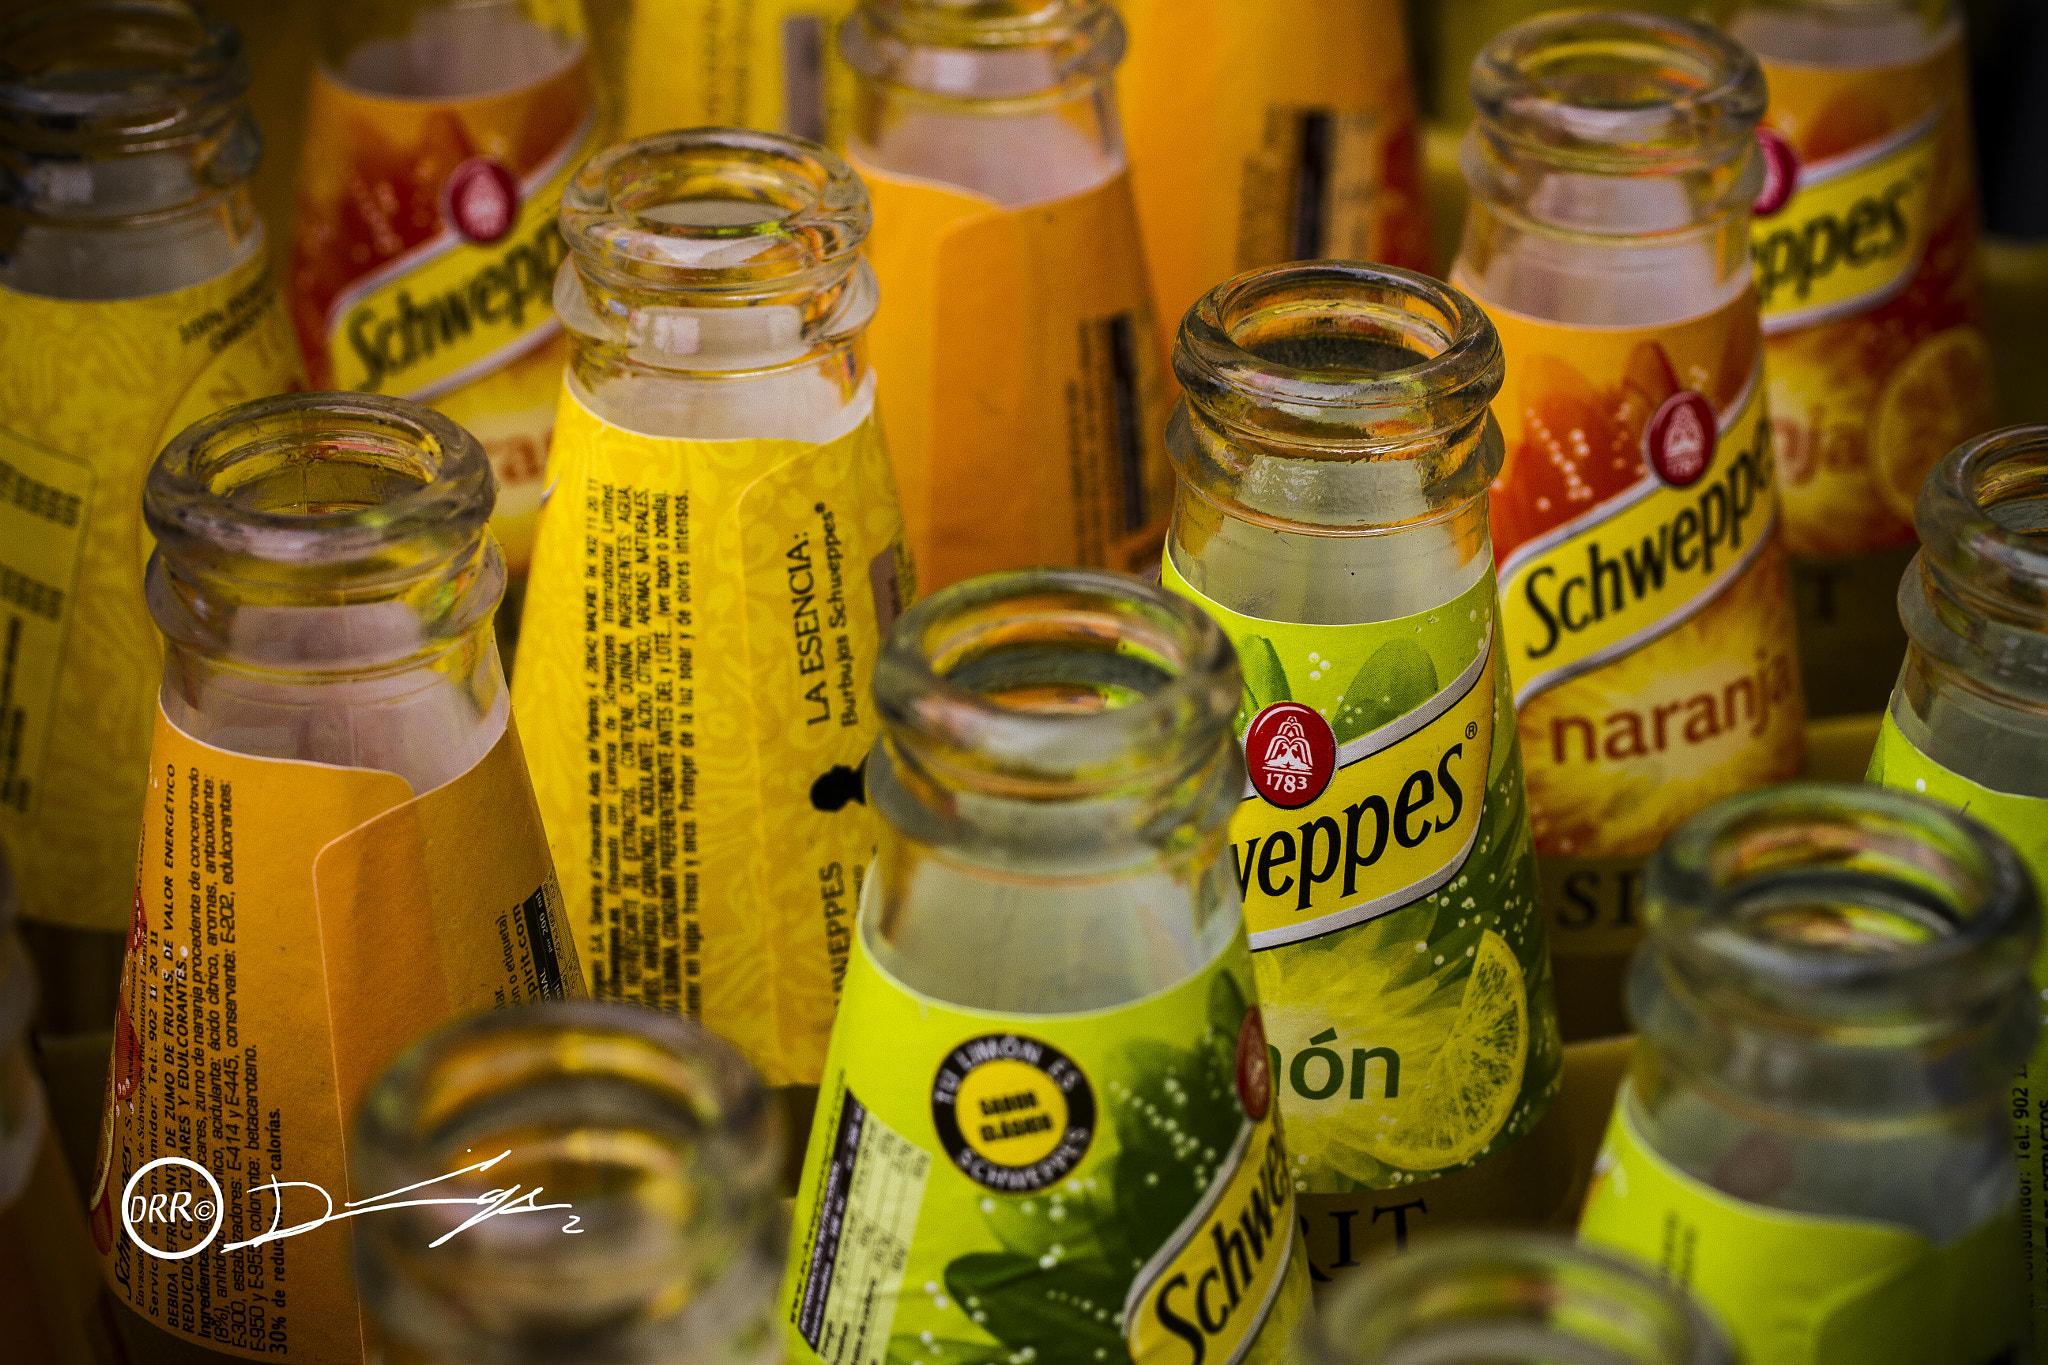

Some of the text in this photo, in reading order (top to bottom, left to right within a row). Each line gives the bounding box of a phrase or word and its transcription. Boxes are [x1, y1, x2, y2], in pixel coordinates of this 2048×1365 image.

[676, 610, 692, 625] de
[786, 531, 831, 726] LA ESENCIA:
[678, 732, 694, 748] de
[1265, 772, 1308, 794] 1783
[188, 767, 200, 868] concentrado
[188, 870, 201, 890] de
[204, 881, 218, 946] aromas,
[218, 892, 236, 944] E-202,
[539, 912, 550, 936] 200
[150, 930, 158, 948] 11
[188, 894, 206, 984] procedente
[495, 910, 518, 984] o etiqueta).
[150, 954, 158, 977] 20
[204, 953, 220, 1005] cítrico,
[138, 979, 147, 1062] International
[190, 986, 205, 1044] naranja
[222, 948, 239, 1048] conservante:
[148, 1009, 158, 1042] 902
[163, 763, 180, 1328] BEBIDA DE ZUMO DE FRUTAS, DE VALOR ENERGÉTICO
[176, 958, 190, 1090] EDULCORANTES.
[206, 1010, 221, 1051] ácido
[148, 1048, 158, 1084] Tel.:
[191, 1048, 205, 1067] de
[953, 1034, 1044, 1072] LIMÓN
[138, 1065, 147, 1139] Schweppes
[178, 1095, 190, 1106] Y
[194, 1069, 206, 1112] zumo
[208, 1058, 224, 1140] acidulante:
[224, 1054, 240, 1106] E-445,
[244, 1044, 260, 1150] betacaroteno.
[230, 1110, 244, 1119] y
[2012, 1088, 2030, 1120] 902
[137, 1142, 145, 1158] de
[226, 1124, 242, 1171] E-414
[265, 1108, 282, 1171] calorías.
[954, 1125, 1090, 1190] SCHWEPPES
[246, 1157, 263, 1232] colorante:
[253, 1293, 268, 1301] y
[271, 1290, 286, 1308] de
[214, 1305, 231, 1344] (8%),
[231, 1298, 248, 1348] E-300,
[250, 1306, 266, 1352] E-950
[268, 1316, 288, 1354] 30%
